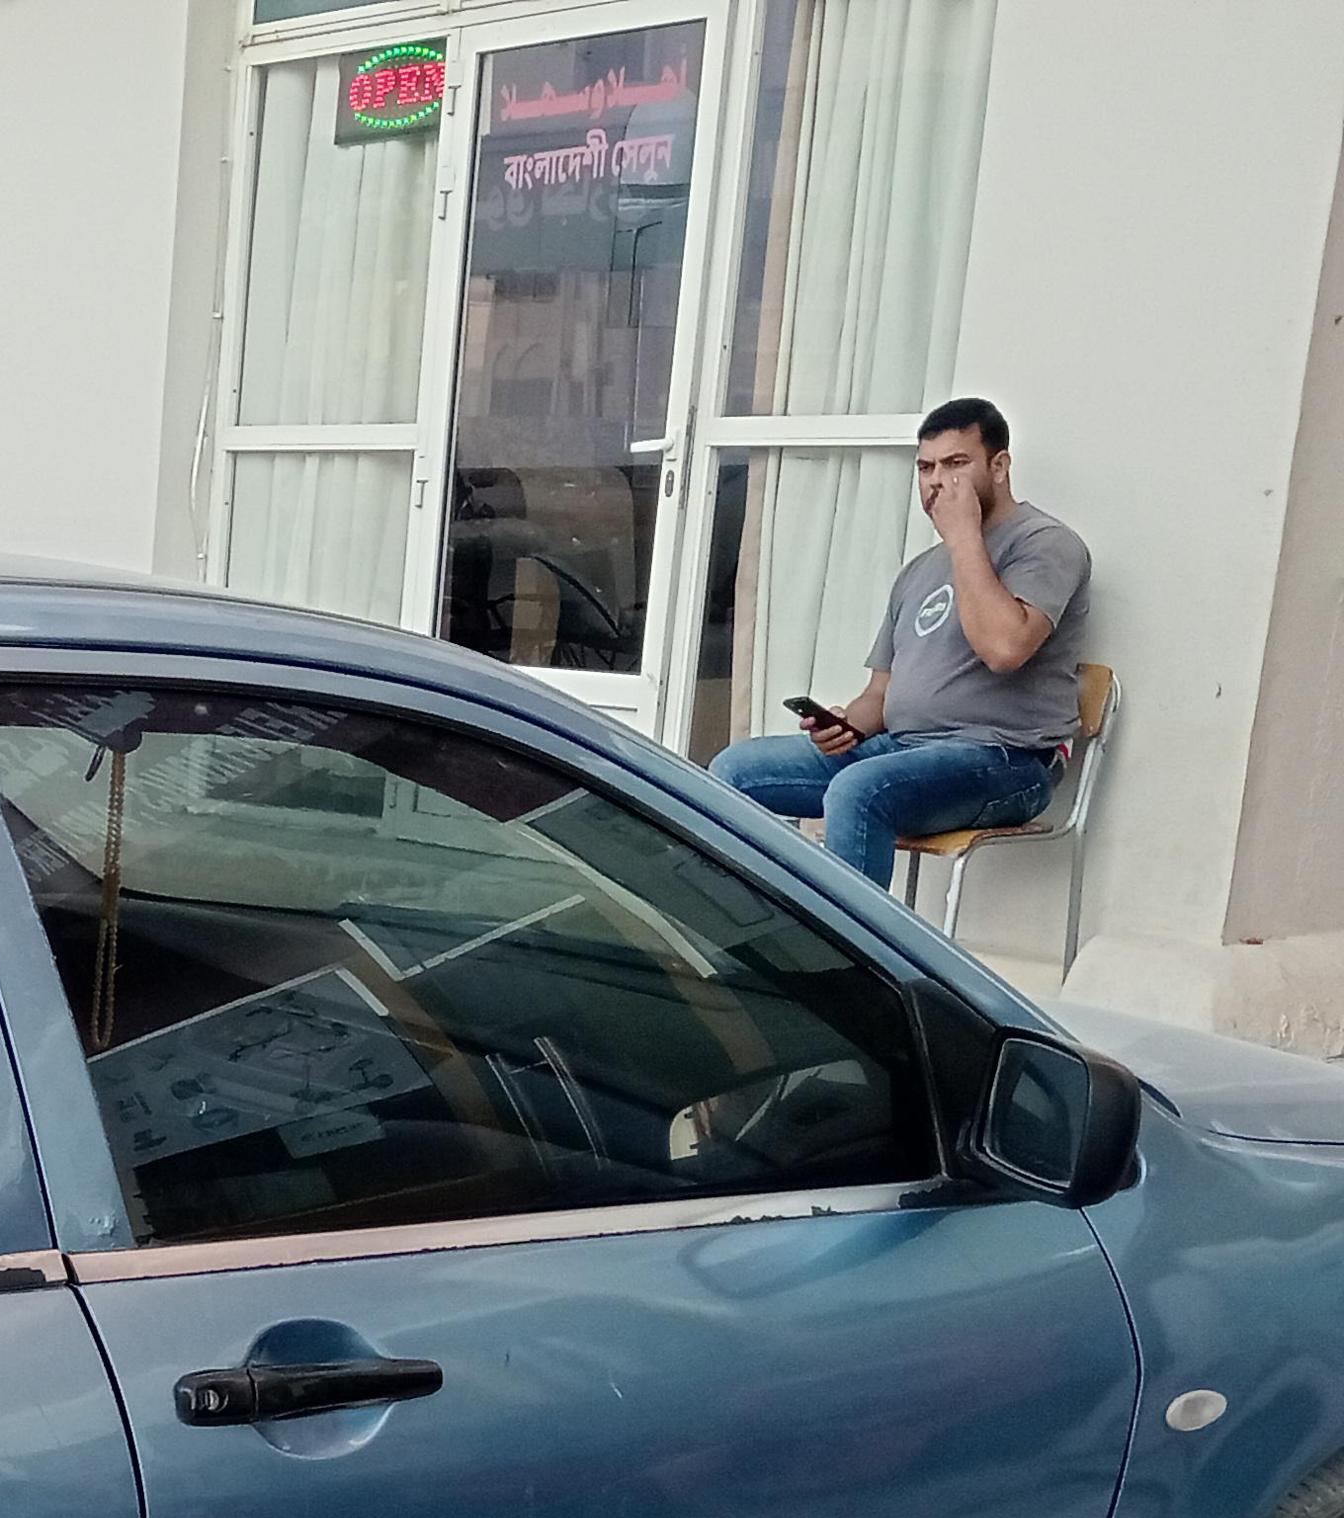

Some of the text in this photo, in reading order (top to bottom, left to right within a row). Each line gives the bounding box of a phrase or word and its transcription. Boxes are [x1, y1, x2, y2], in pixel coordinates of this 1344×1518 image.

[349, 61, 445, 110] OPEN
[504, 128, 676, 190] বাংলাদেশী সেলুন
